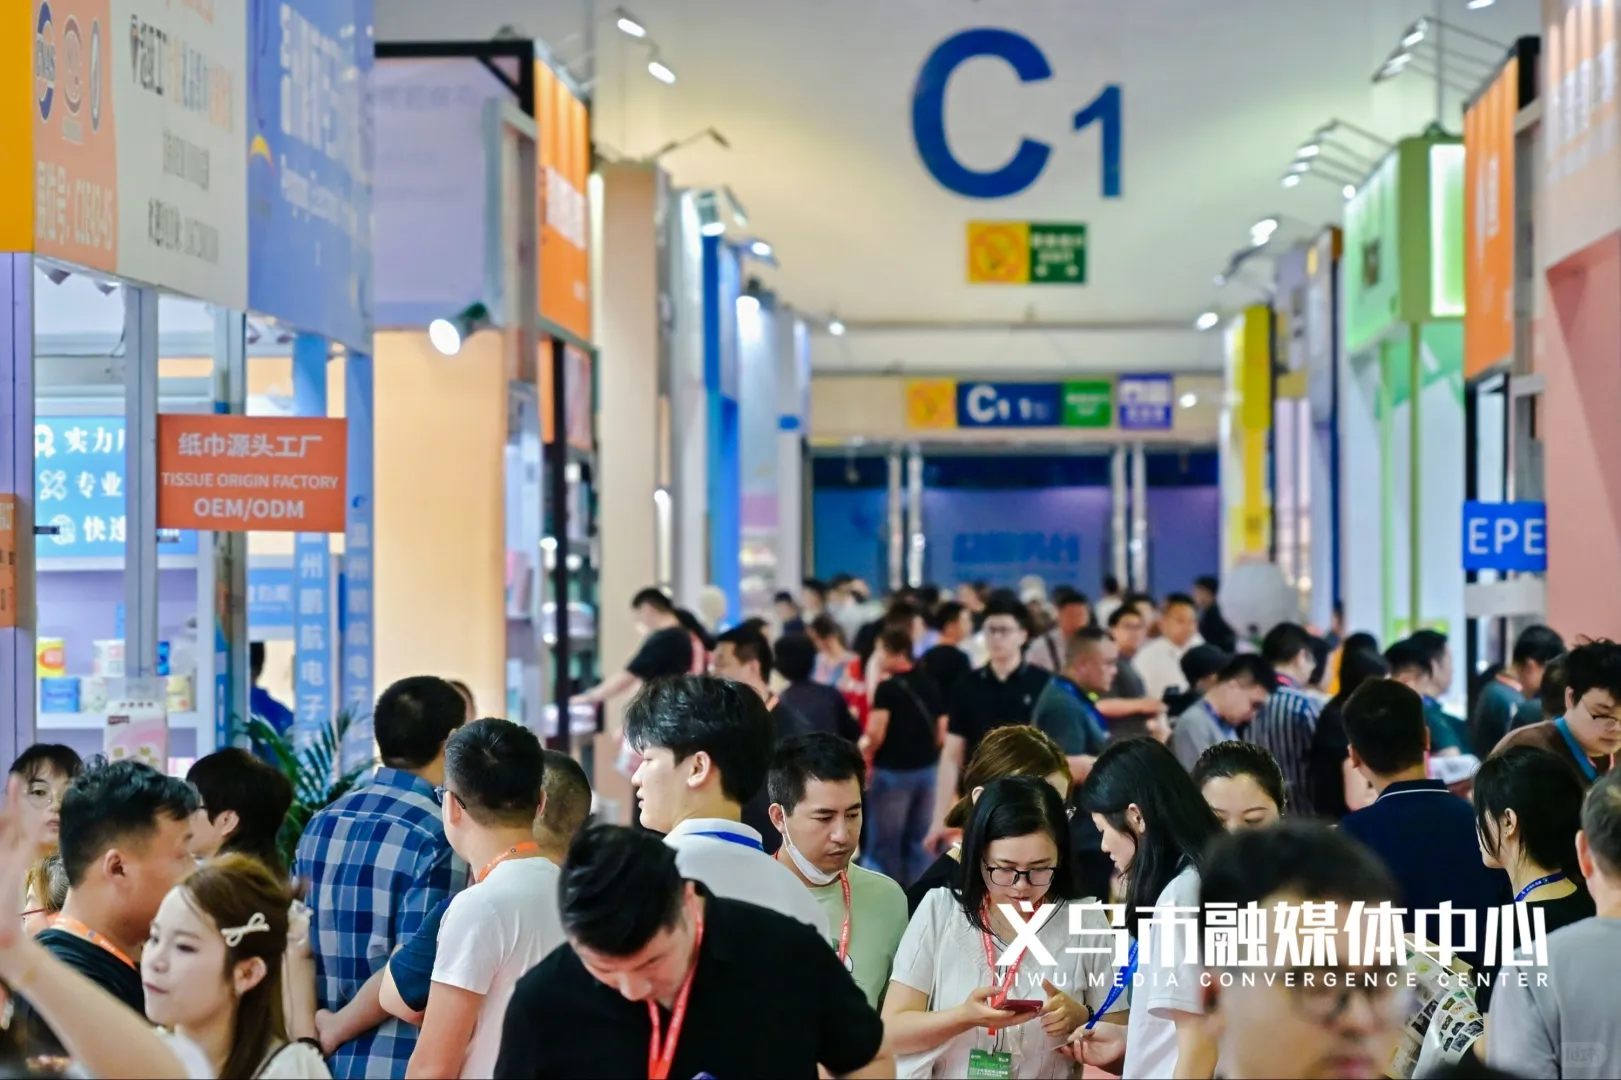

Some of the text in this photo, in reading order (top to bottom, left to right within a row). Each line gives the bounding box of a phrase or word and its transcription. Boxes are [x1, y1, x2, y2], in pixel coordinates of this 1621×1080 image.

[912, 27, 1122, 199] C1
[178, 432, 322, 458] 纸巾源头工厂
[75, 471, 123, 499] 专业
[161, 472, 339, 489] TISSUE ORIGIN FACTORY
[193, 497, 305, 521] OEM/ODM
[1468, 517, 1545, 556] EPE
